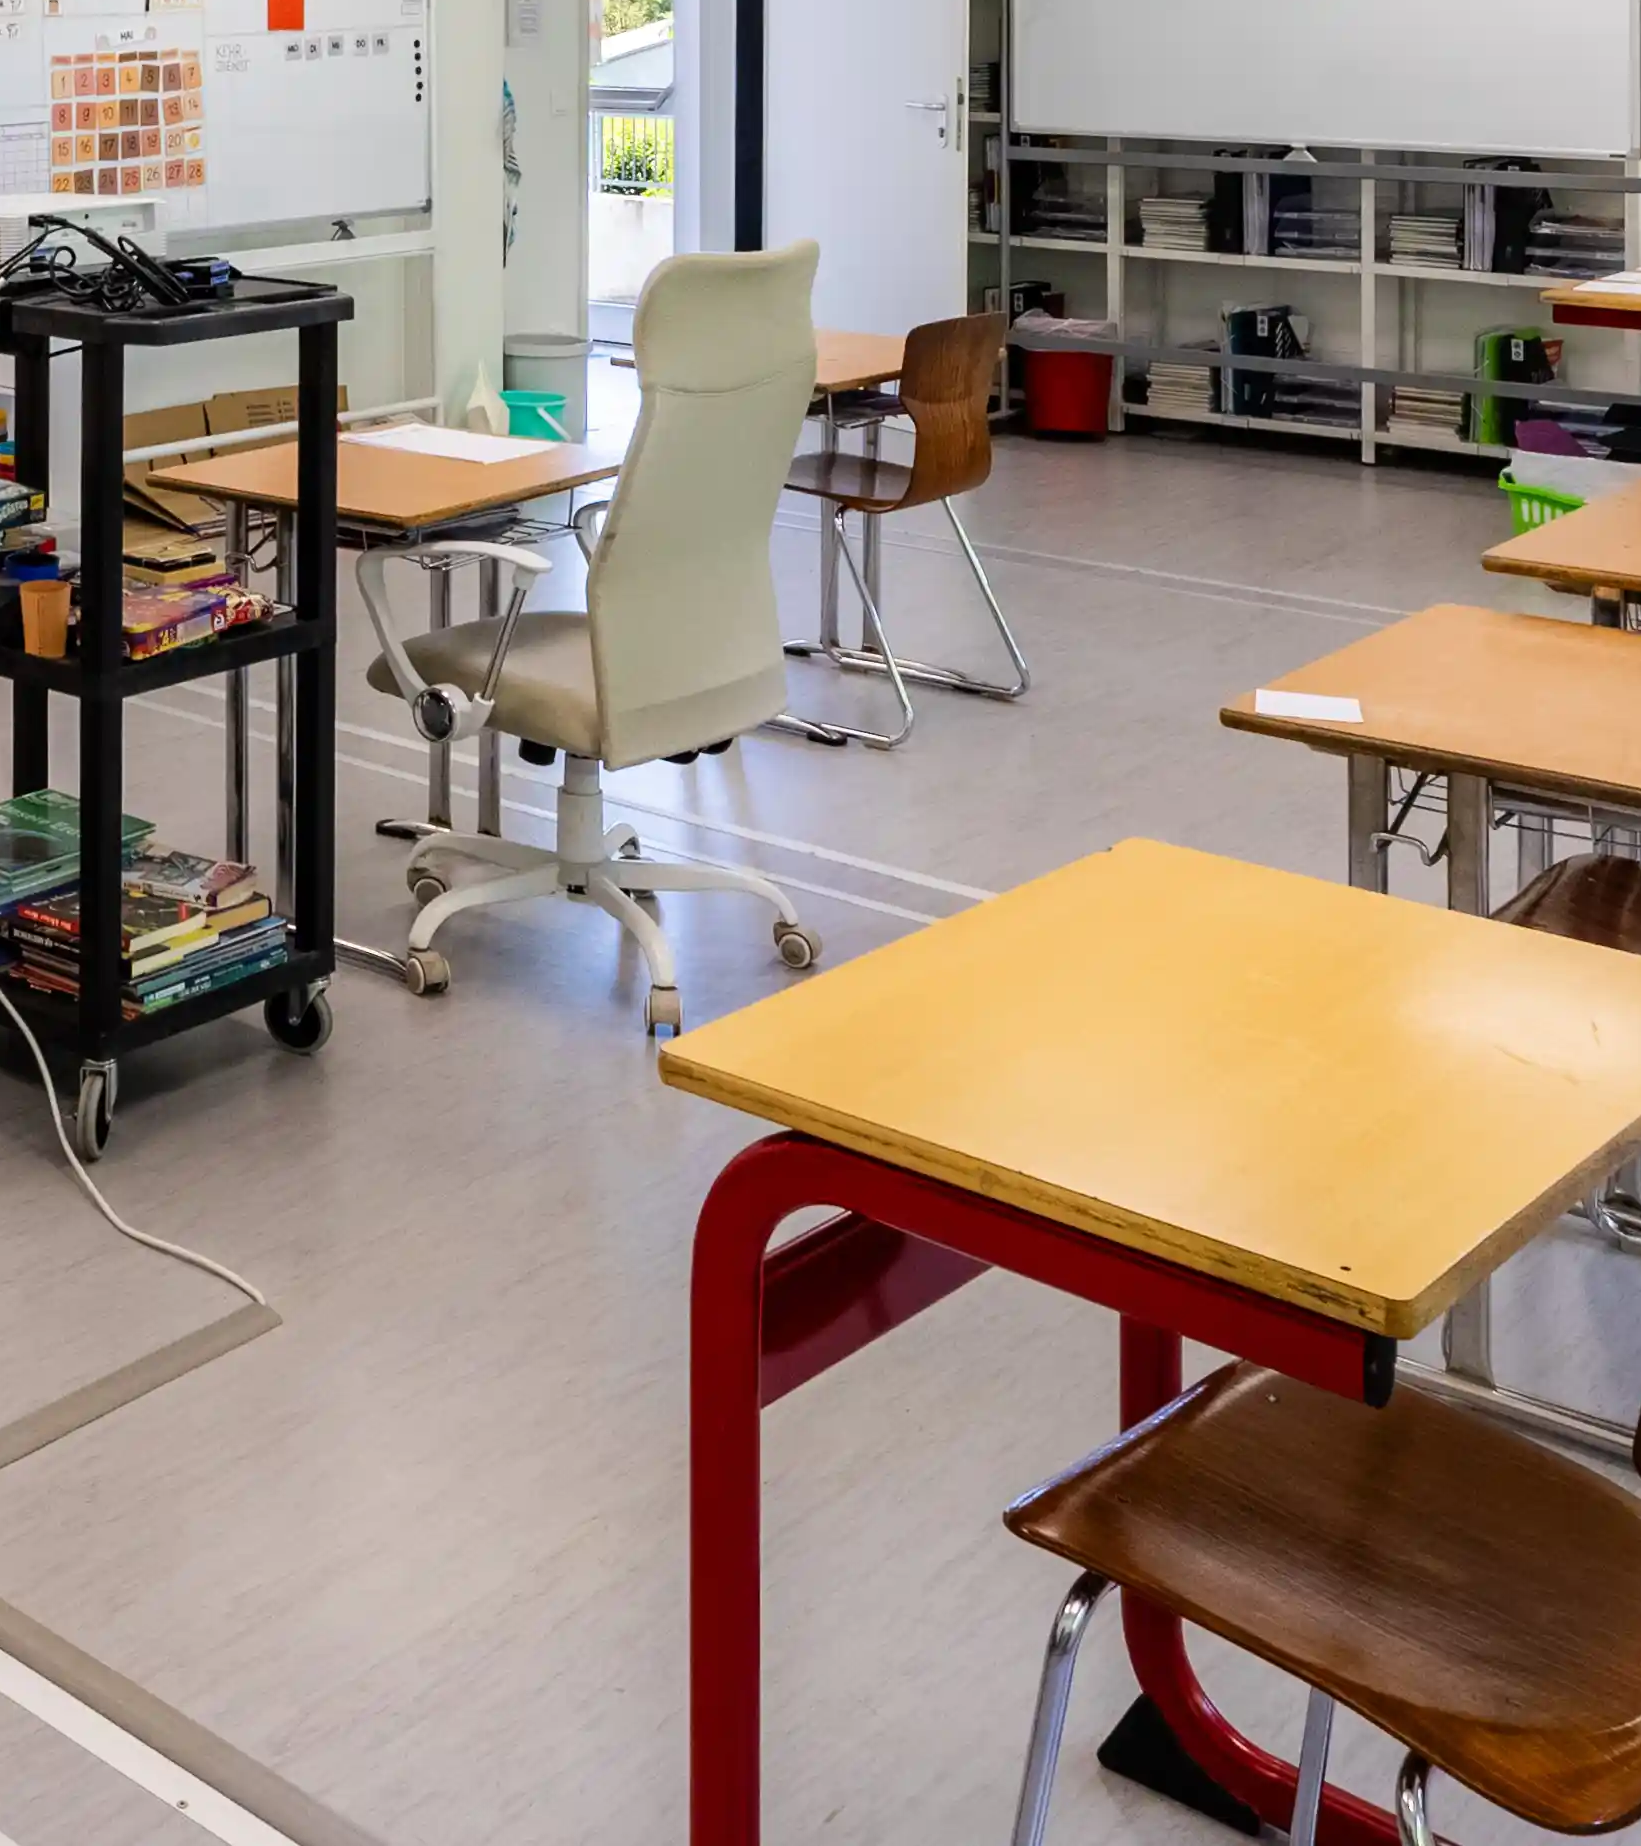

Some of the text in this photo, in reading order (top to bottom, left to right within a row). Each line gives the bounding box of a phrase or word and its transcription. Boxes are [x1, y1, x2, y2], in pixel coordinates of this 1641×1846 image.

[80, 74, 88, 87] 2
[102, 74, 110, 88] 3
[168, 135, 181, 148] 20
[147, 167, 160, 181] 26
